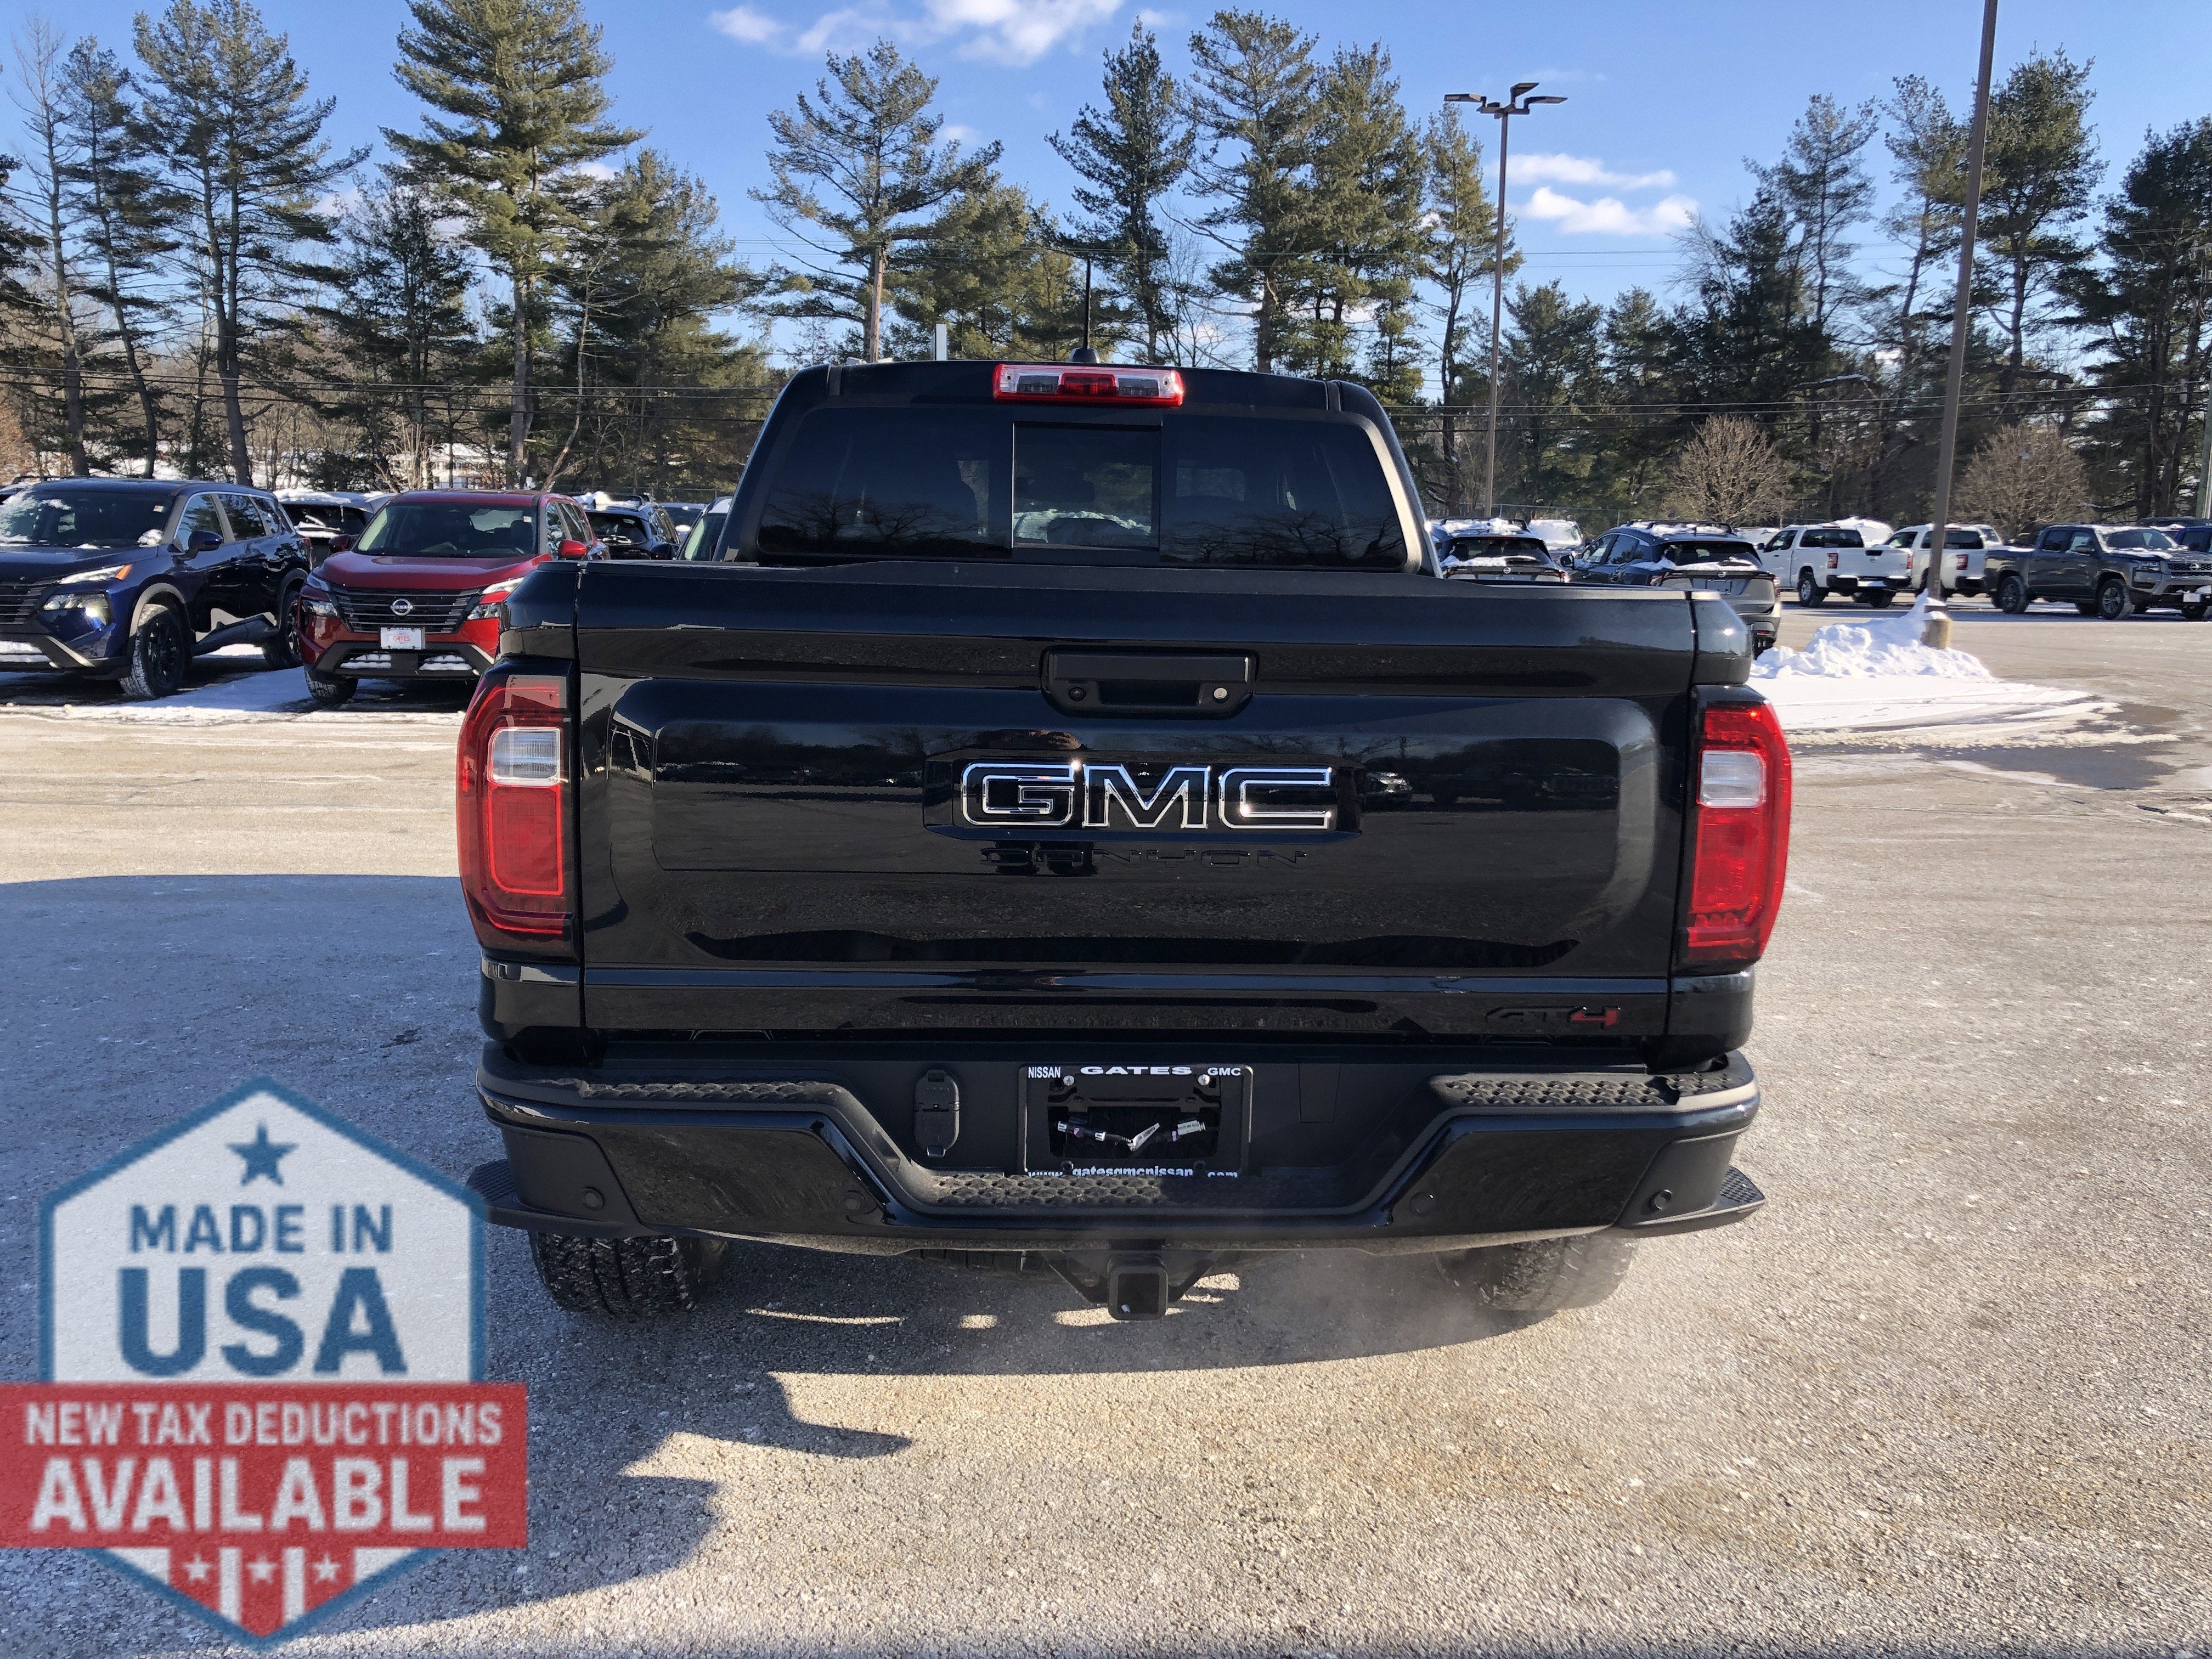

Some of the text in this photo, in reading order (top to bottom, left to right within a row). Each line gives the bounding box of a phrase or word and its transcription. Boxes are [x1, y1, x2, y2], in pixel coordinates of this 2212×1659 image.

[962, 763, 1331, 830] GMC
[980, 848, 1307, 868] CANYON
[1485, 1005, 1620, 1029] AT4
[1028, 1066, 1241, 1079] NISSAN GATES GMC
